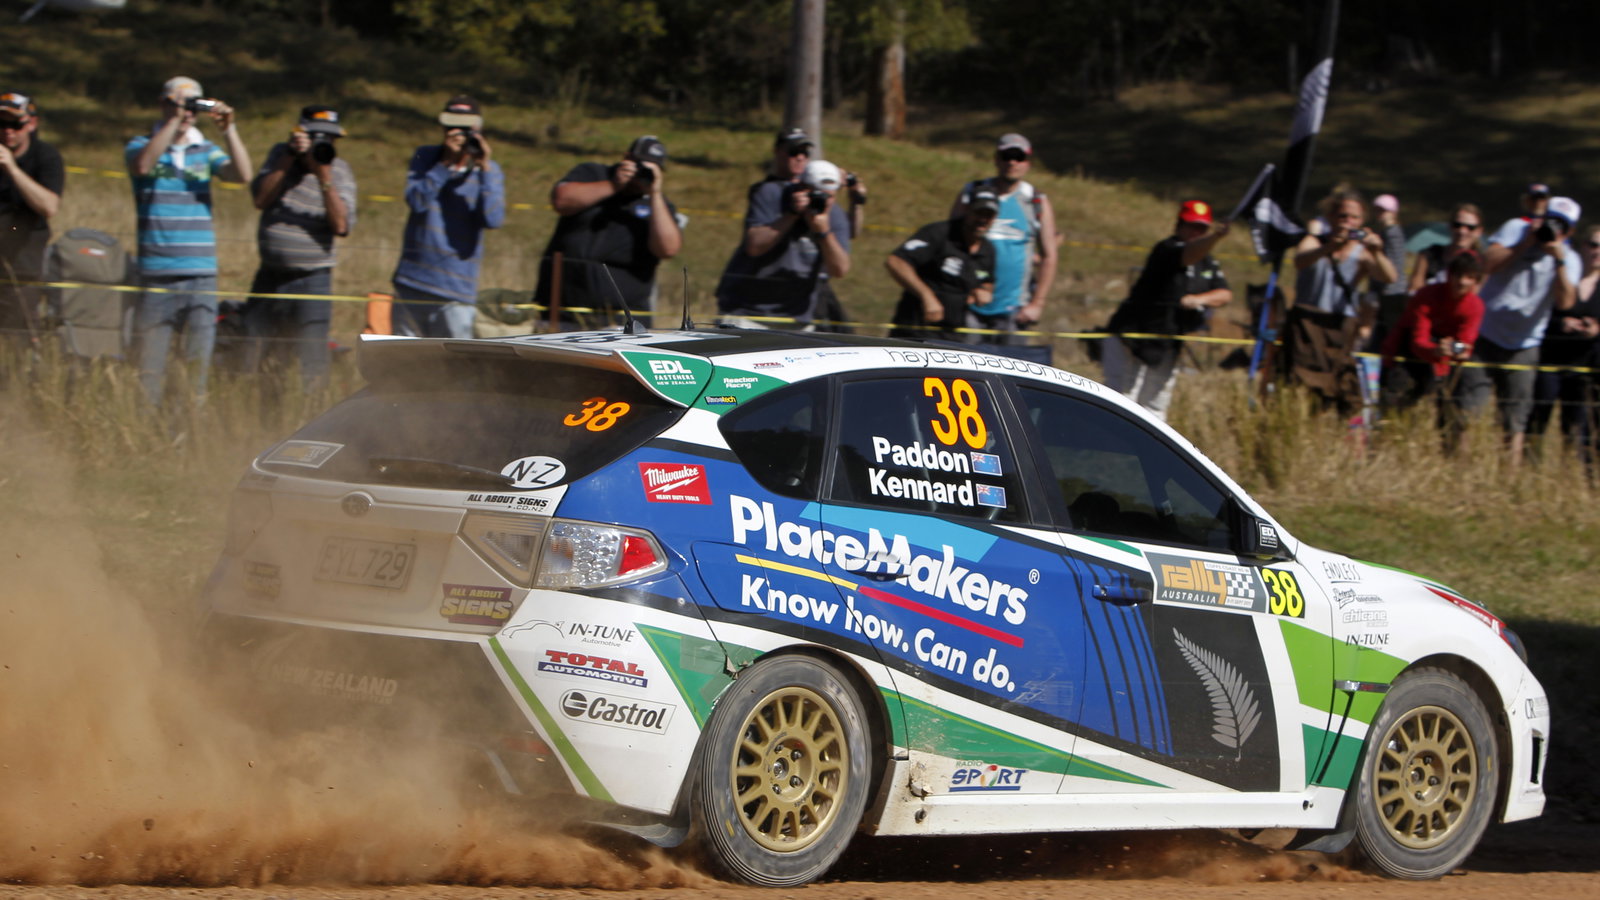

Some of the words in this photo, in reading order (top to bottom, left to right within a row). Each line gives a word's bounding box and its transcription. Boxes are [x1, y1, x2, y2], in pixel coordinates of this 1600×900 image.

[648, 360, 692, 374] EDL
[884, 348, 1100, 391] haydenpaddon.com
[563, 397, 631, 432] 38
[923, 377, 988, 450] 38
[872, 436, 970, 474] Paddon
[644, 465, 700, 487] Milwaukee
[868, 468, 975, 506] Kennard
[467, 494, 483, 503] ALL
[484, 494, 516, 504] ABOUT
[519, 497, 548, 508] SIGNS
[1261, 526, 1277, 538] EDL
[729, 494, 1029, 626] PlaceMakers
[1322, 561, 1362, 580] ENDLESS
[450, 587, 468, 598] ALL
[468, 588, 504, 599] ABOUT
[1160, 559, 1228, 605] rally
[1261, 568, 1303, 617] 38
[1161, 589, 1217, 604] AUSTRALIA
[441, 598, 514, 620] SIGNS
[1343, 609, 1387, 624] chicane
[568, 622, 636, 643] IN-TUNE
[581, 637, 621, 648] Automotive
[741, 574, 839, 625] Know
[844, 595, 910, 653] how.
[914, 626, 967, 676] Can
[973, 648, 1016, 693] do.
[1346, 633, 1389, 647] IN-TUNE
[545, 649, 645, 677] TOTAL
[310, 668, 399, 698] ZEALAND
[542, 664, 645, 687] AUTOMOTIVE
[588, 698, 668, 730] Castrol
[951, 766, 1028, 786] SPORT
